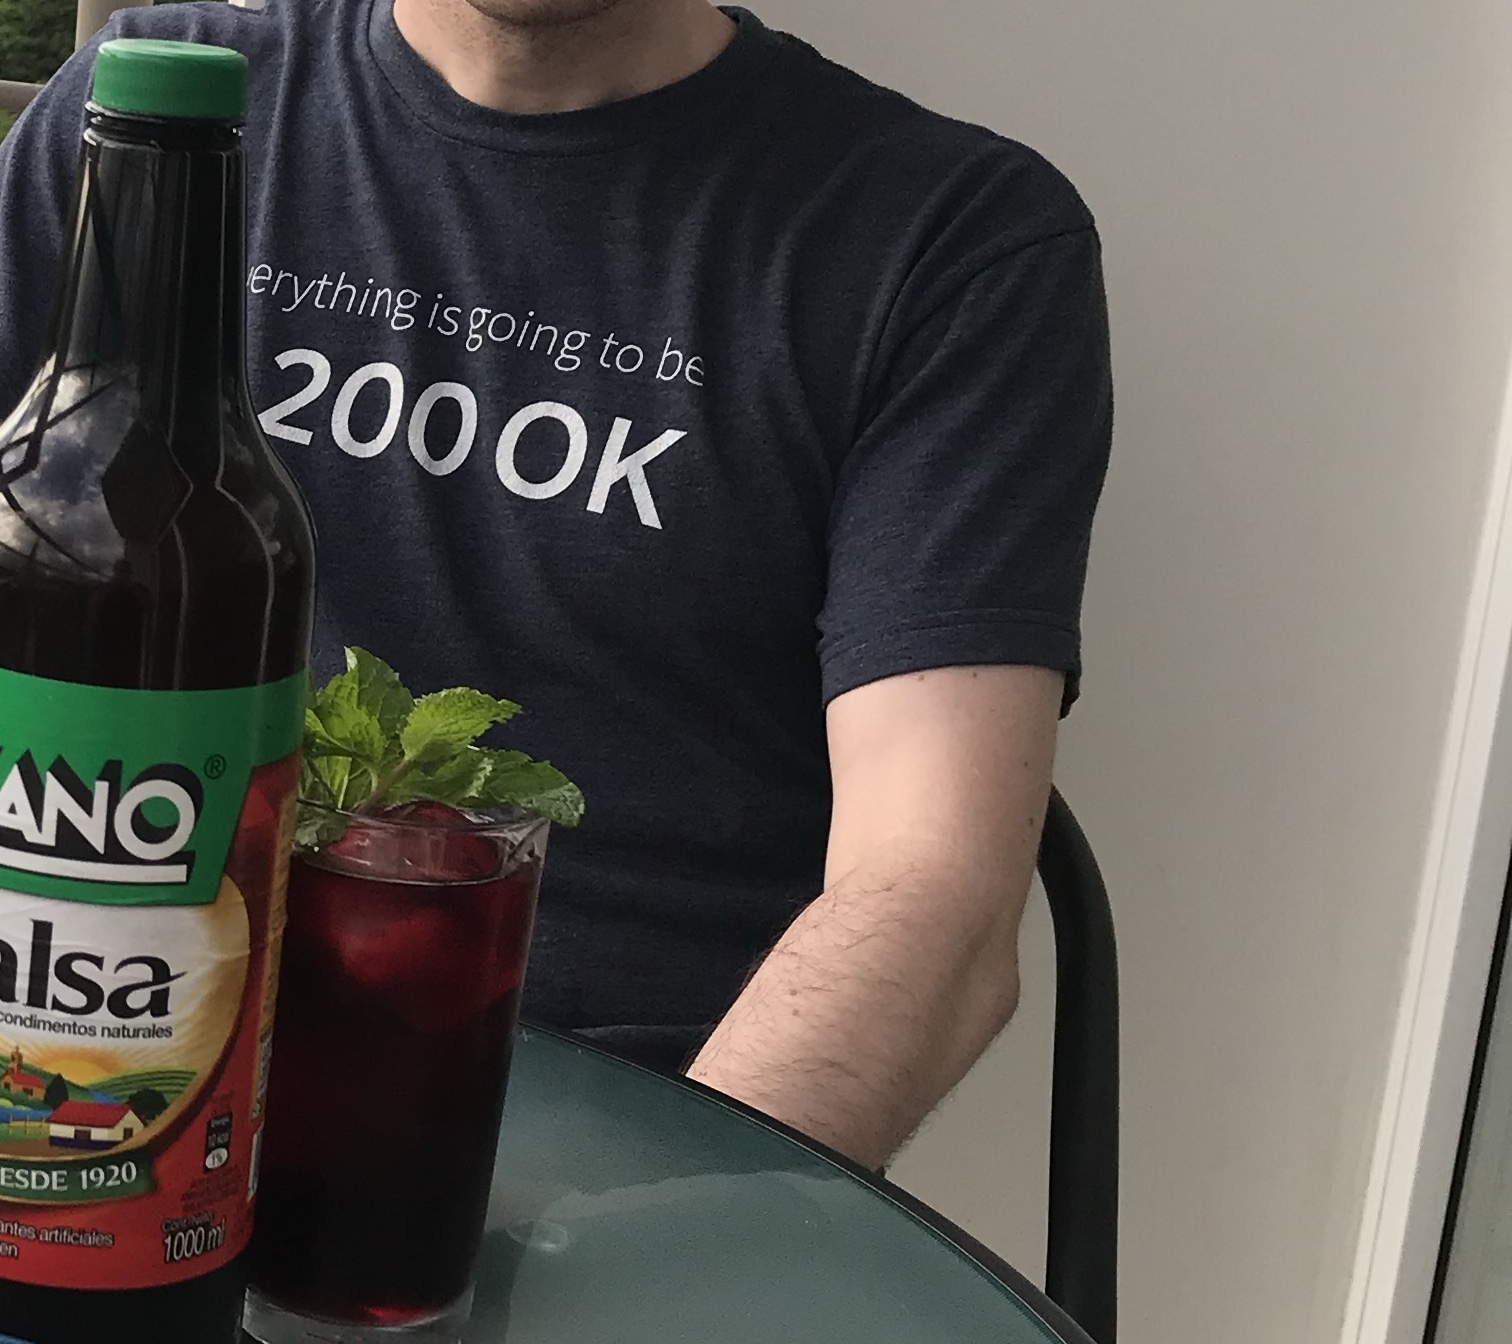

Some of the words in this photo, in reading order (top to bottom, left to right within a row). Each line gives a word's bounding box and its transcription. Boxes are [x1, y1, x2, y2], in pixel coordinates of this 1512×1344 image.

[428, 293, 462, 336] is
[465, 307, 591, 372] going
[599, 332, 644, 373] to
[655, 337, 705, 387] be
[257, 348, 478, 477] 200
[495, 400, 688, 530] OK
[100, 1023, 173, 1039] naturales
[80, 1160, 137, 1191] 1920
[39, 1226, 114, 1248] artificiales
[164, 1226, 205, 1263] 1000
[207, 1217, 225, 1251] ml
